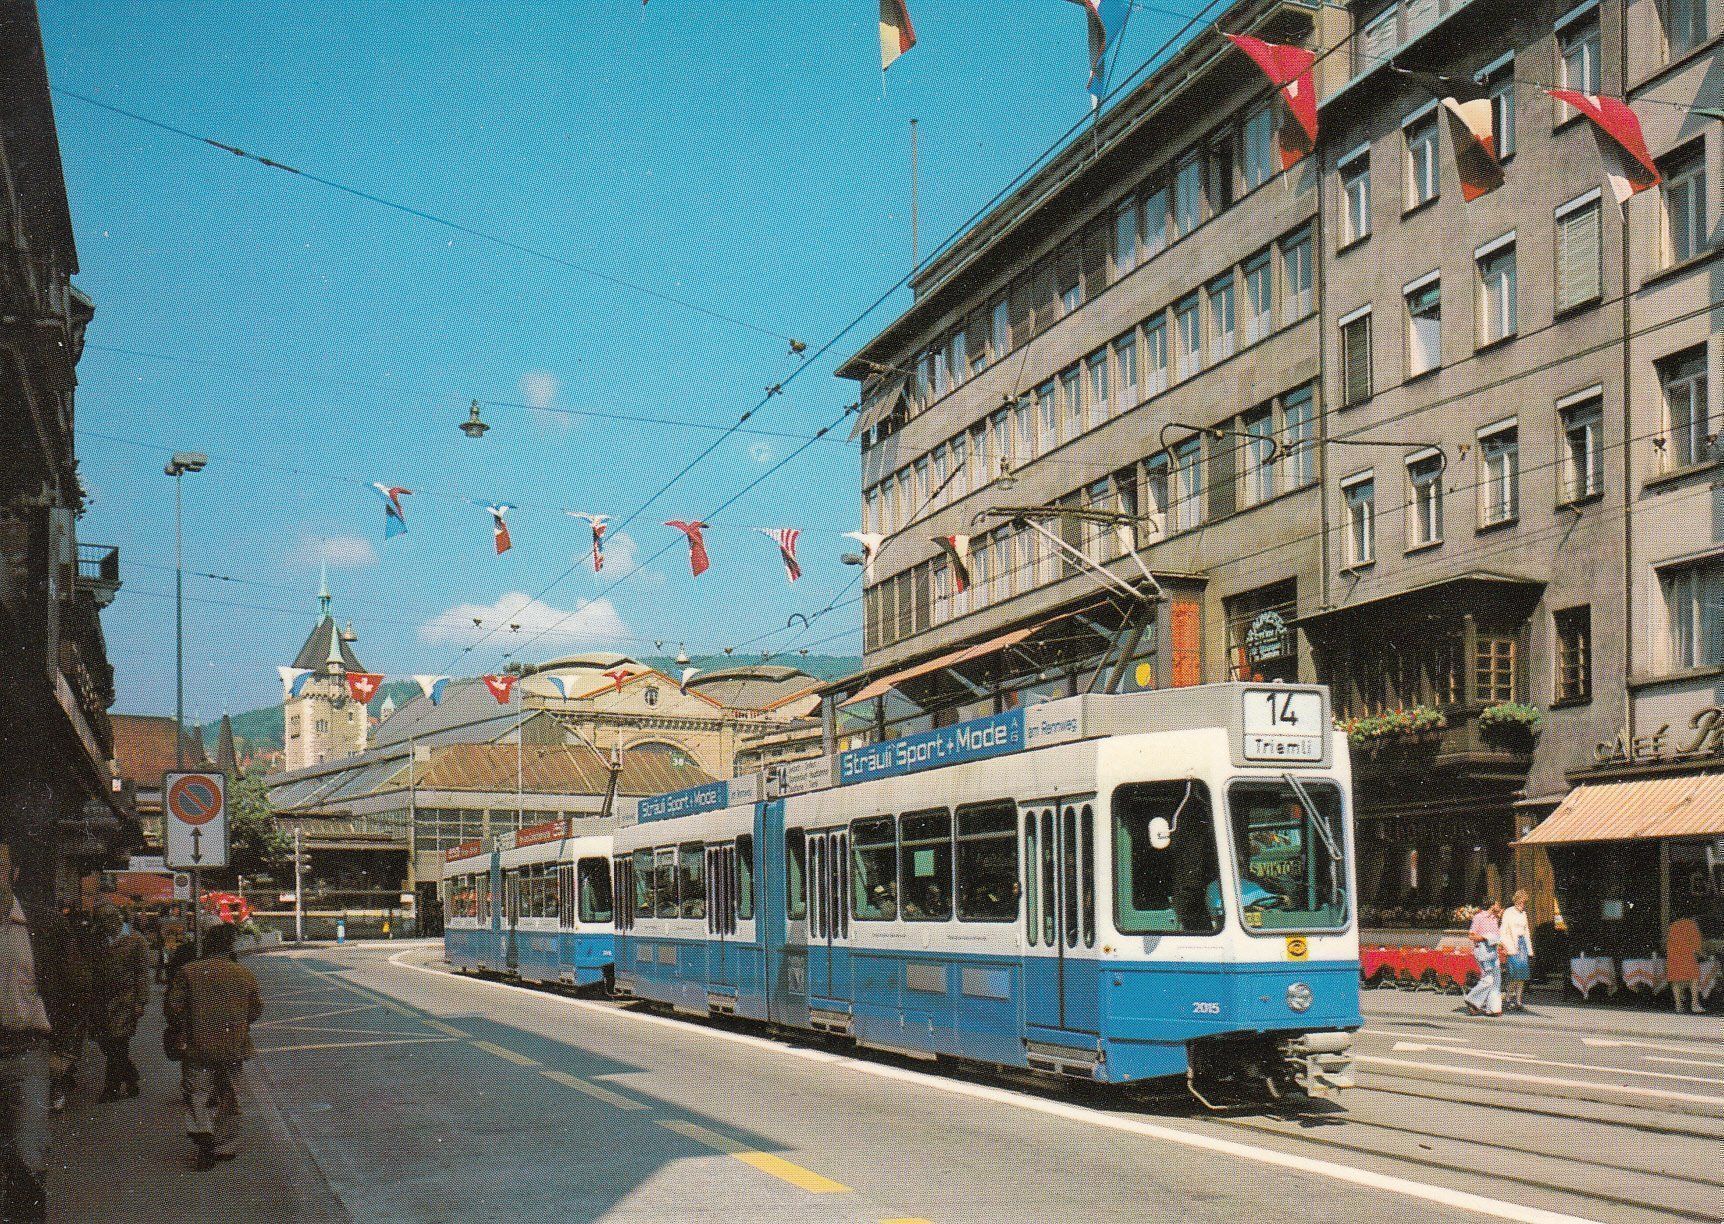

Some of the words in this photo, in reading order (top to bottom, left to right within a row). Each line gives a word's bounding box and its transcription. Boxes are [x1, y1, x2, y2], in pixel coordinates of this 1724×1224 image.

[1266, 691, 1299, 726] 14
[843, 745, 892, 775] Sträuli
[896, 733, 945, 769] Sport
[956, 721, 1007, 751] Mode
[1255, 738, 1312, 755] Triemli
[1594, 723, 1670, 761] CAFÉ
[667, 792, 689, 815] Sport
[694, 788, 717, 807] Mode
[1193, 1002, 1220, 1014] 2015
